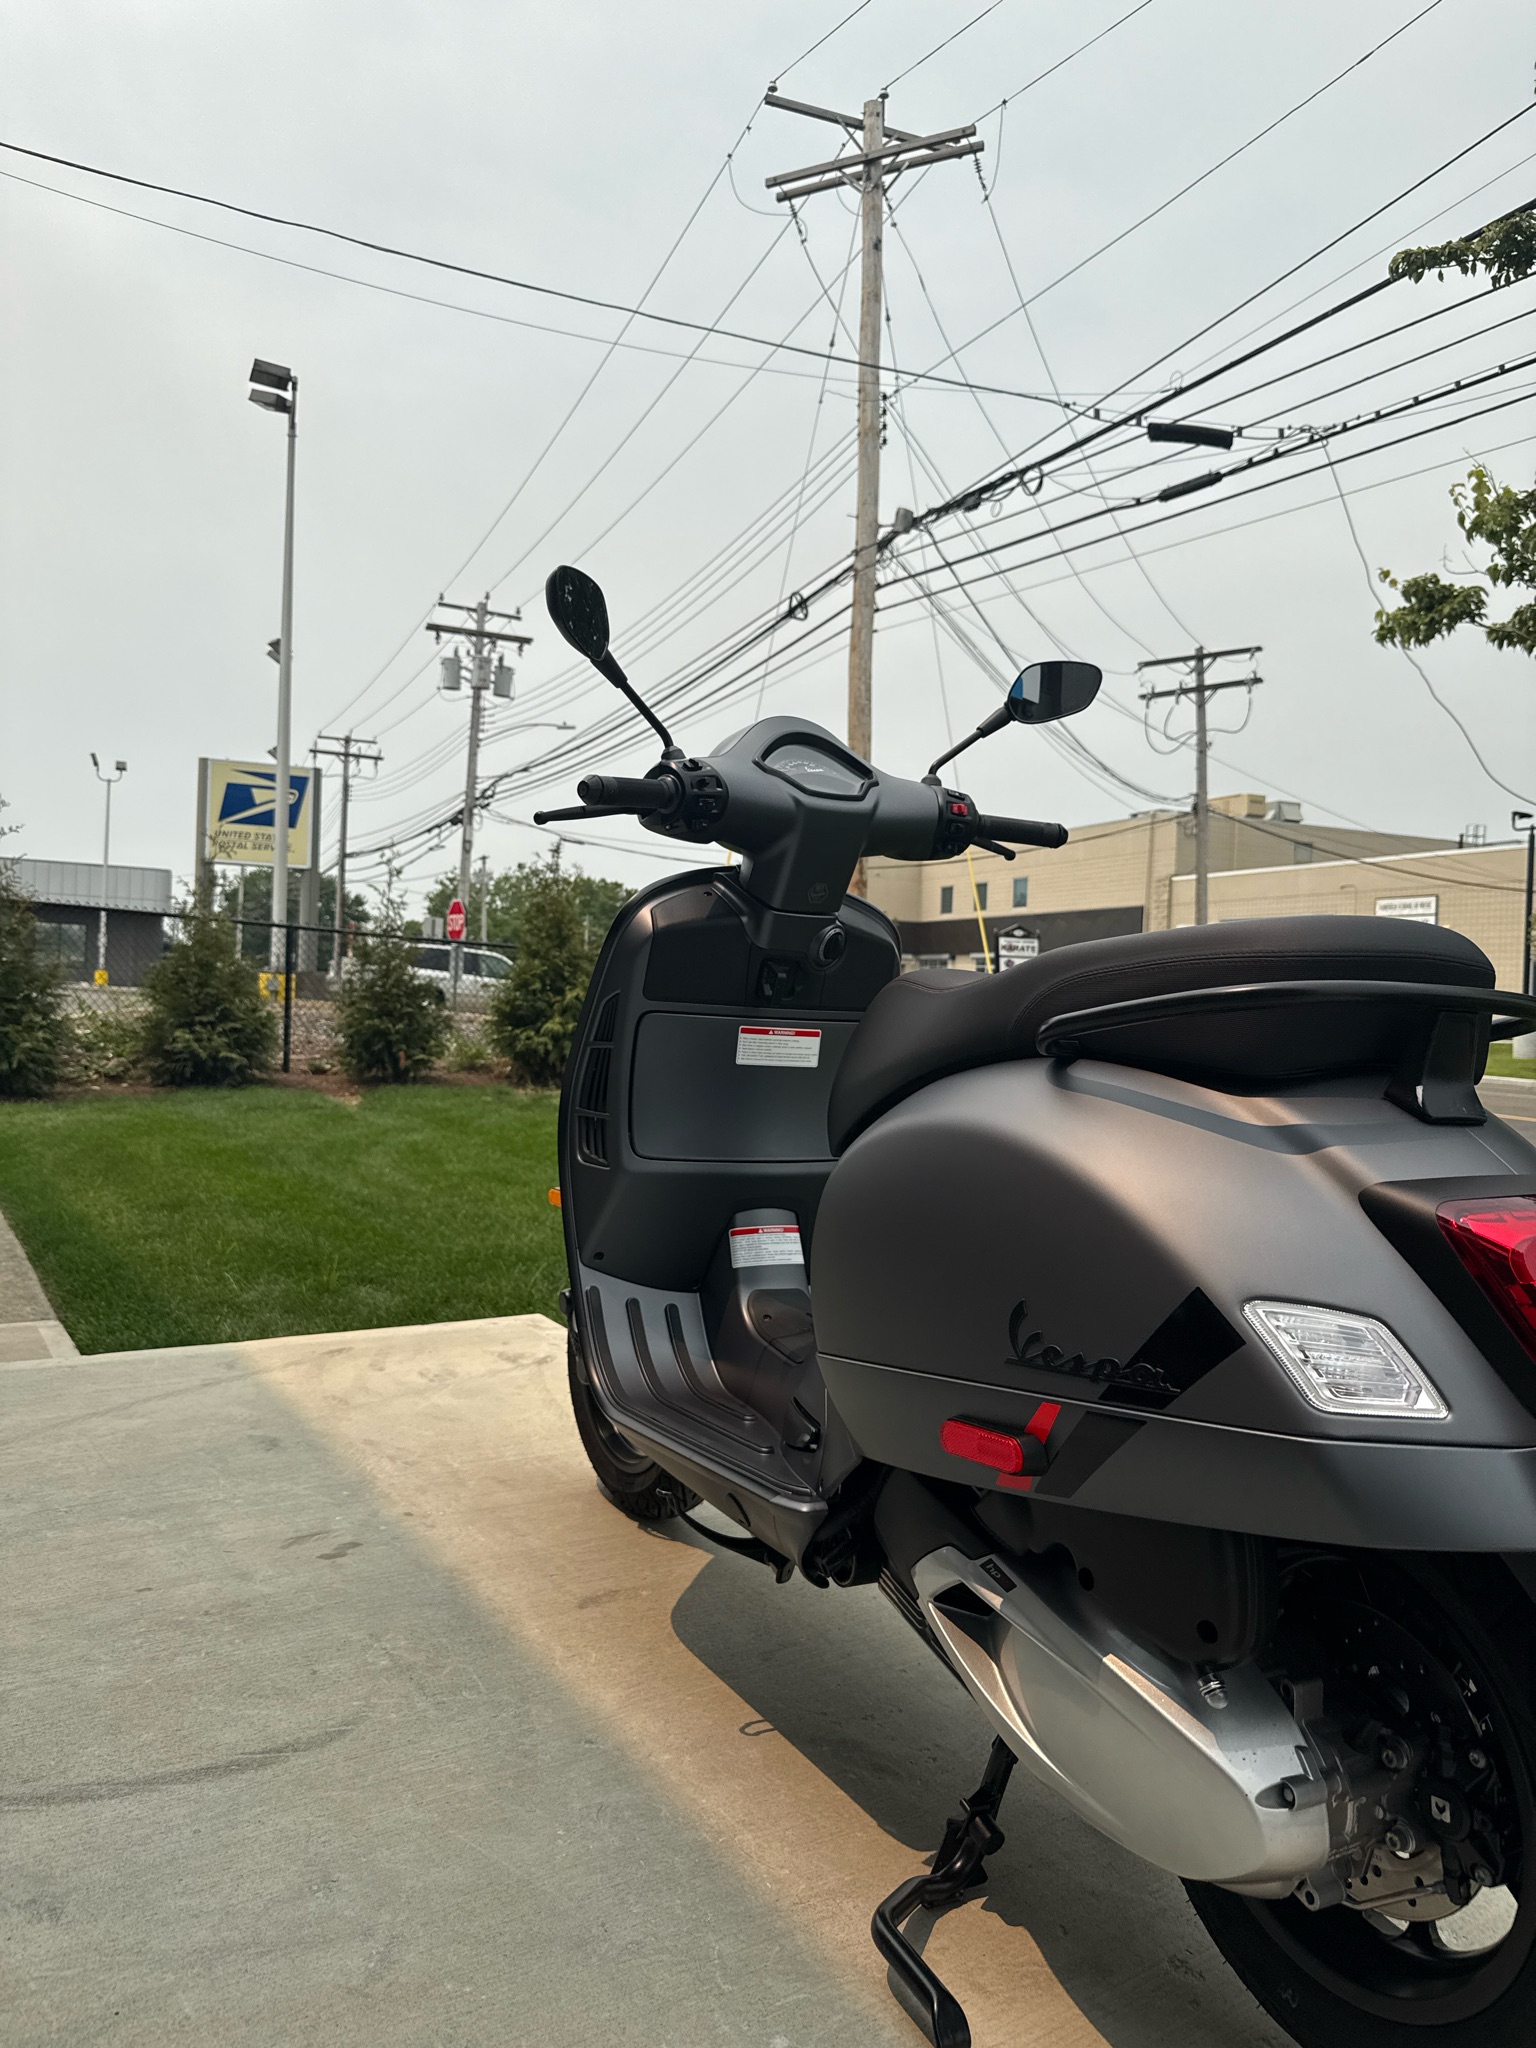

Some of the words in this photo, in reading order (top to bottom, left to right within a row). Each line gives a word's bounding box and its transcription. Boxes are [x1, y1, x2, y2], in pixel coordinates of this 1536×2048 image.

[214, 830, 252, 840] UNITED
[447, 914, 465, 931] STOP
[1005, 1298, 1181, 1395] Vespa
